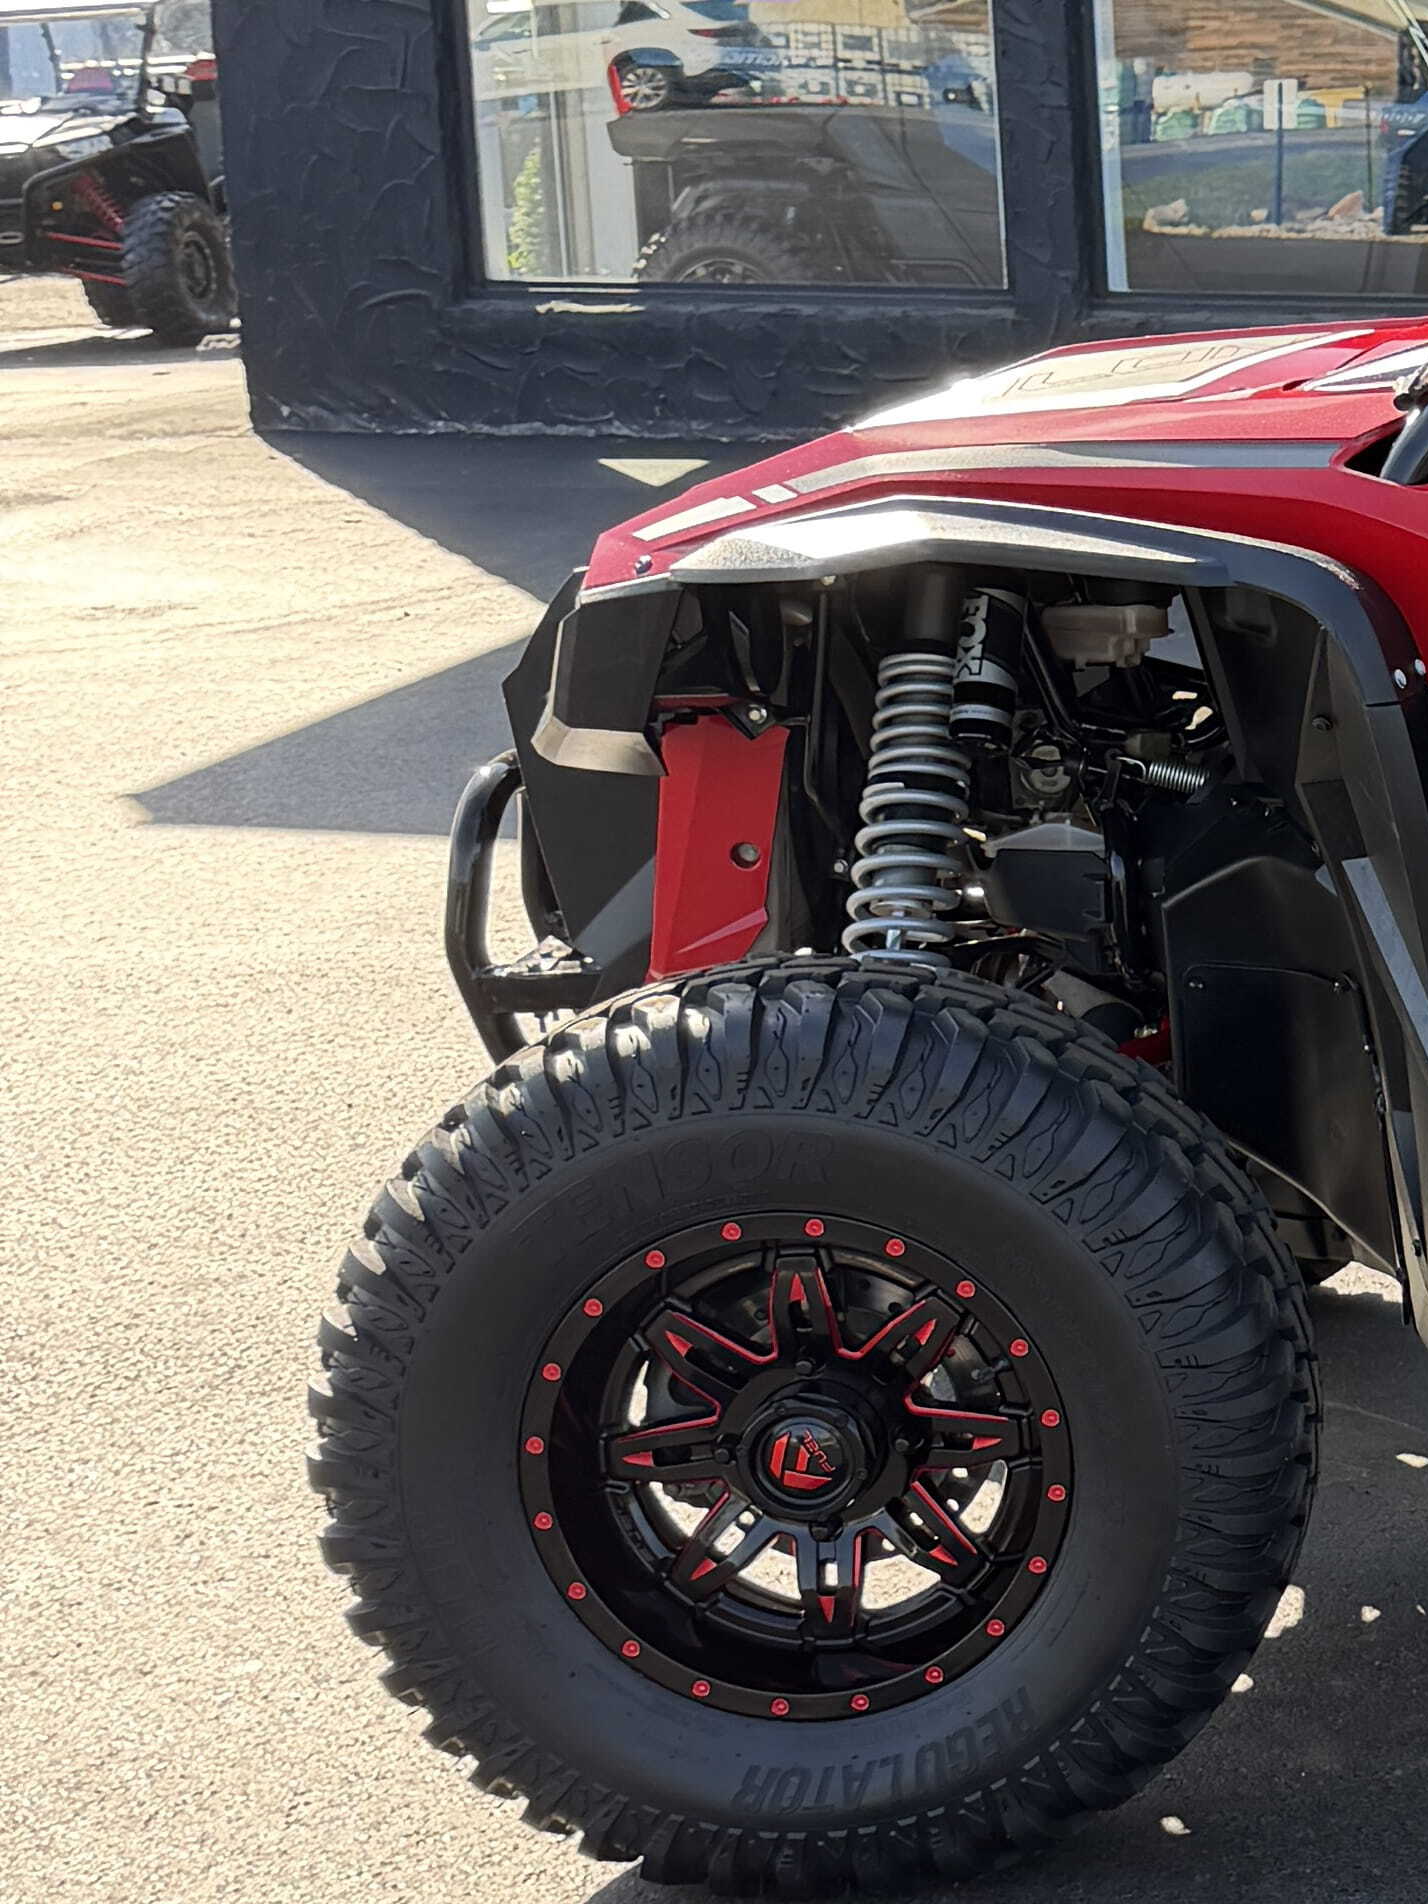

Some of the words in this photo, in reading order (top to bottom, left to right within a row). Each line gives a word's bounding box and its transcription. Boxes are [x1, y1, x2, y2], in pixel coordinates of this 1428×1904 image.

[953, 595, 991, 679] FOX
[803, 1427, 836, 1472] FUEL
[730, 1685, 1042, 1817] REGULATOR
